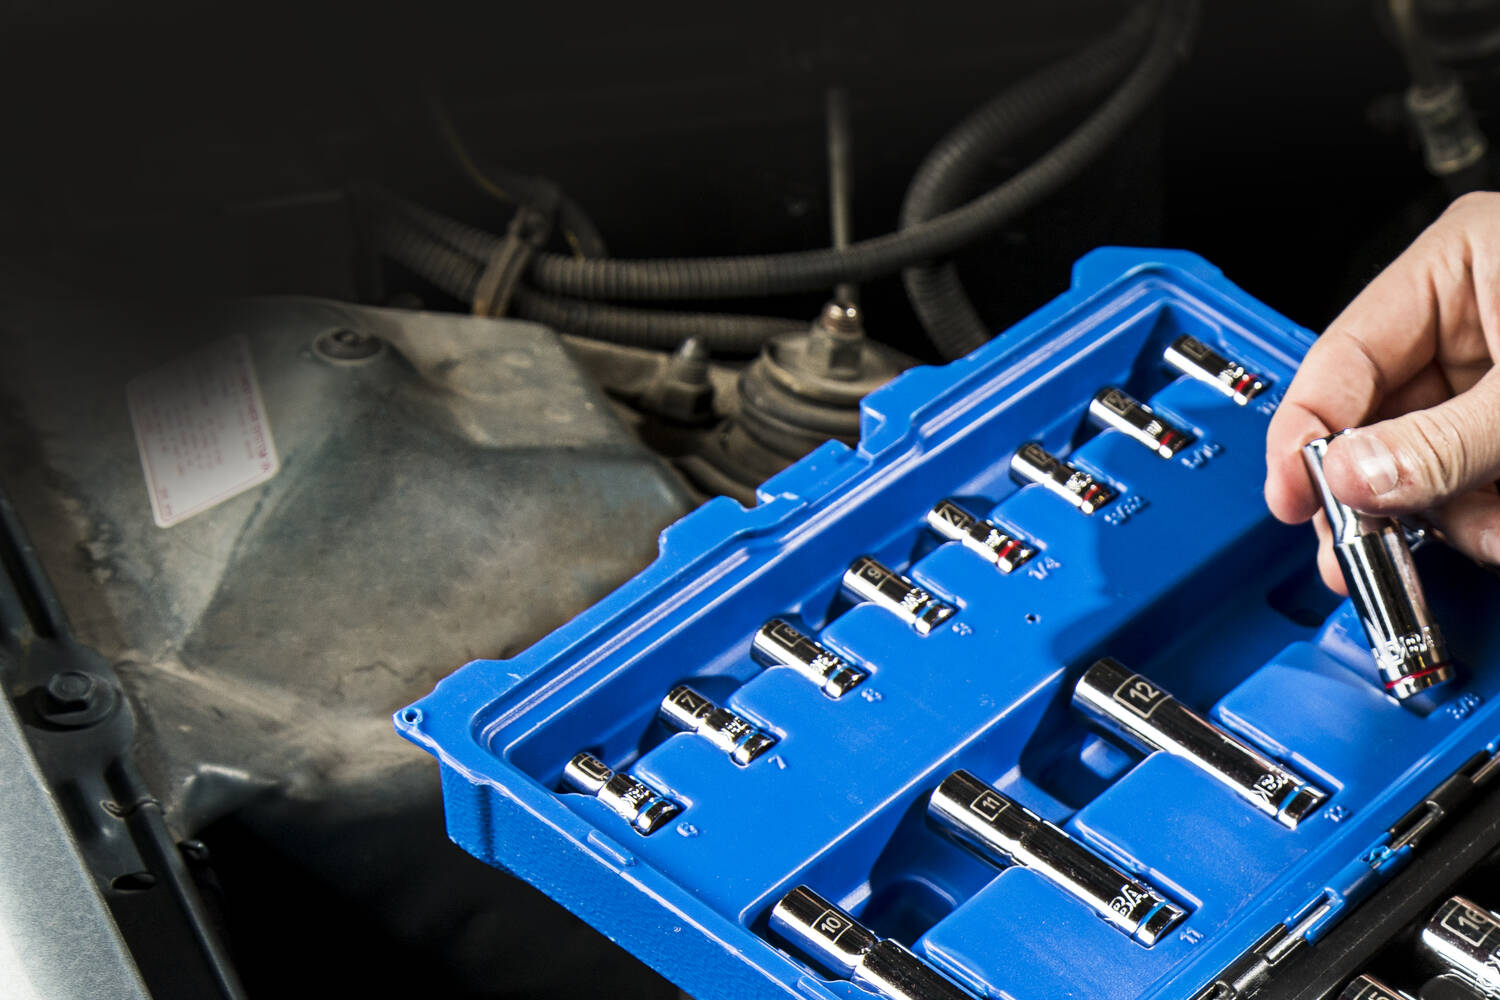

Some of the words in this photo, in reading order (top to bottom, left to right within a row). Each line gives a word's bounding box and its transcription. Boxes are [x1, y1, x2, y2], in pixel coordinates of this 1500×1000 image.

[1128, 680, 1161, 703] 12
[680, 694, 697, 709] 7
[767, 755, 788, 770] 7
[981, 795, 1001, 811] 11
[820, 915, 843, 934] 10
[1457, 908, 1489, 932] 16
